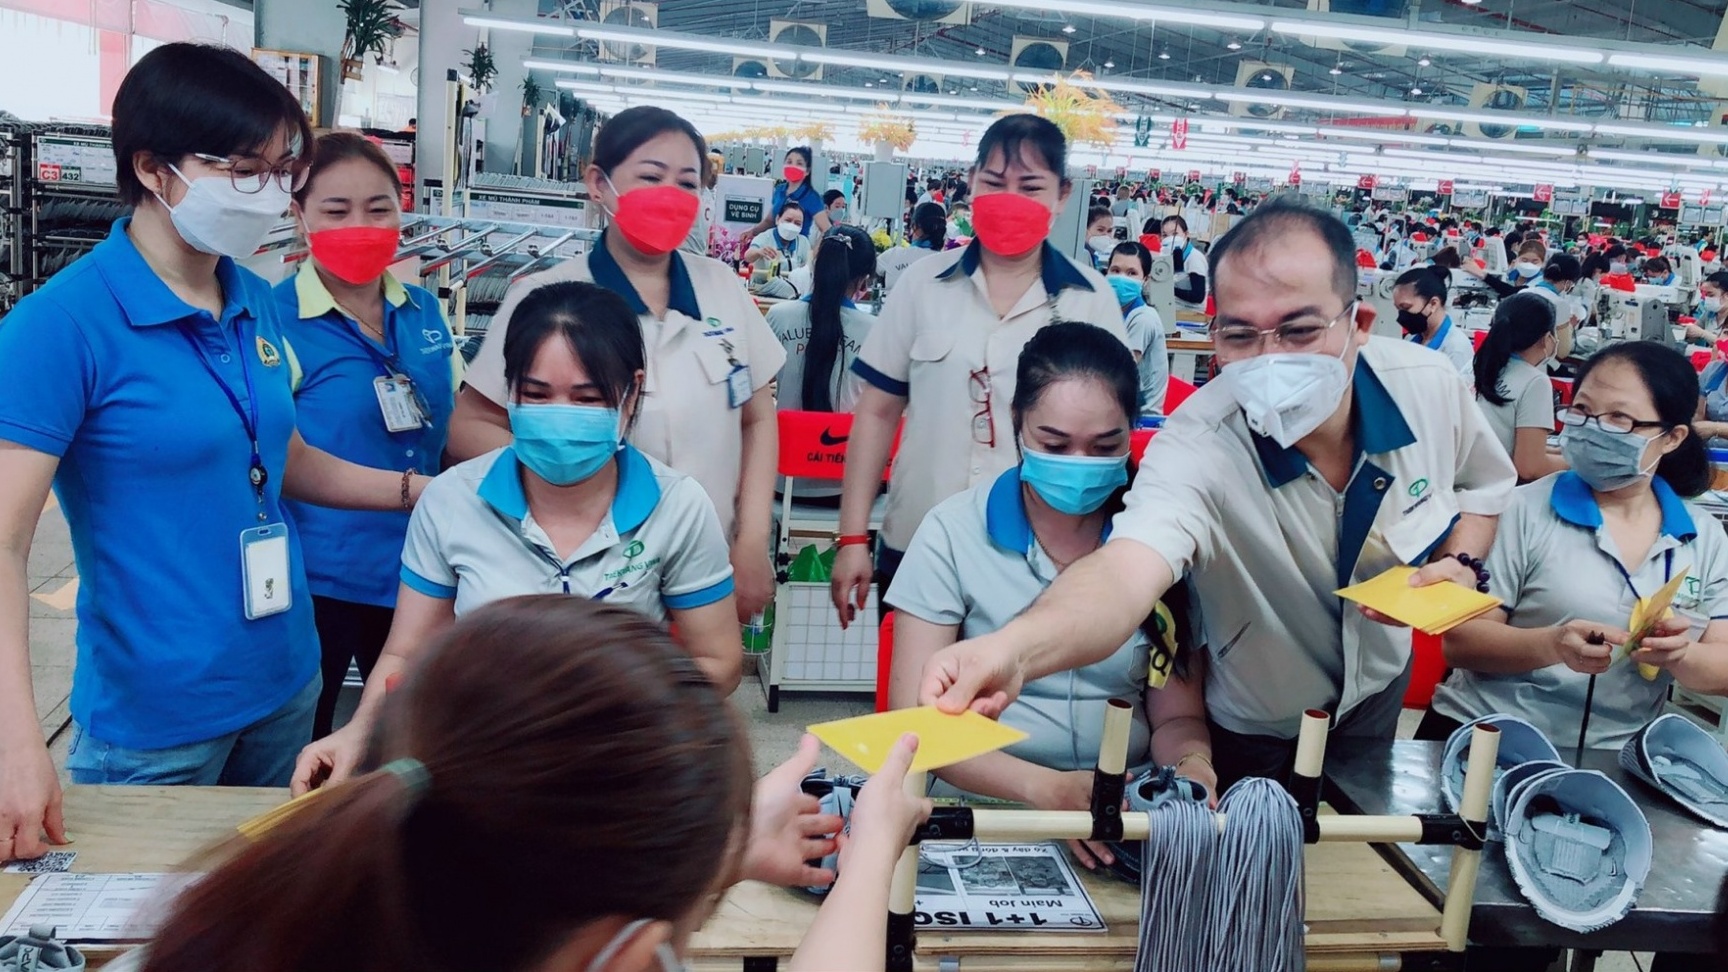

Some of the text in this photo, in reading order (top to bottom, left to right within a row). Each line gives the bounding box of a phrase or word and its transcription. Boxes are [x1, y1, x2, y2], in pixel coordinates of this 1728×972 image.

[41, 170, 58, 180] C3
[62, 172, 79, 181] 432
[988, 899, 1016, 908] Job
[1020, 899, 1063, 908] Main
[985, 911, 1048, 925] 1+1
